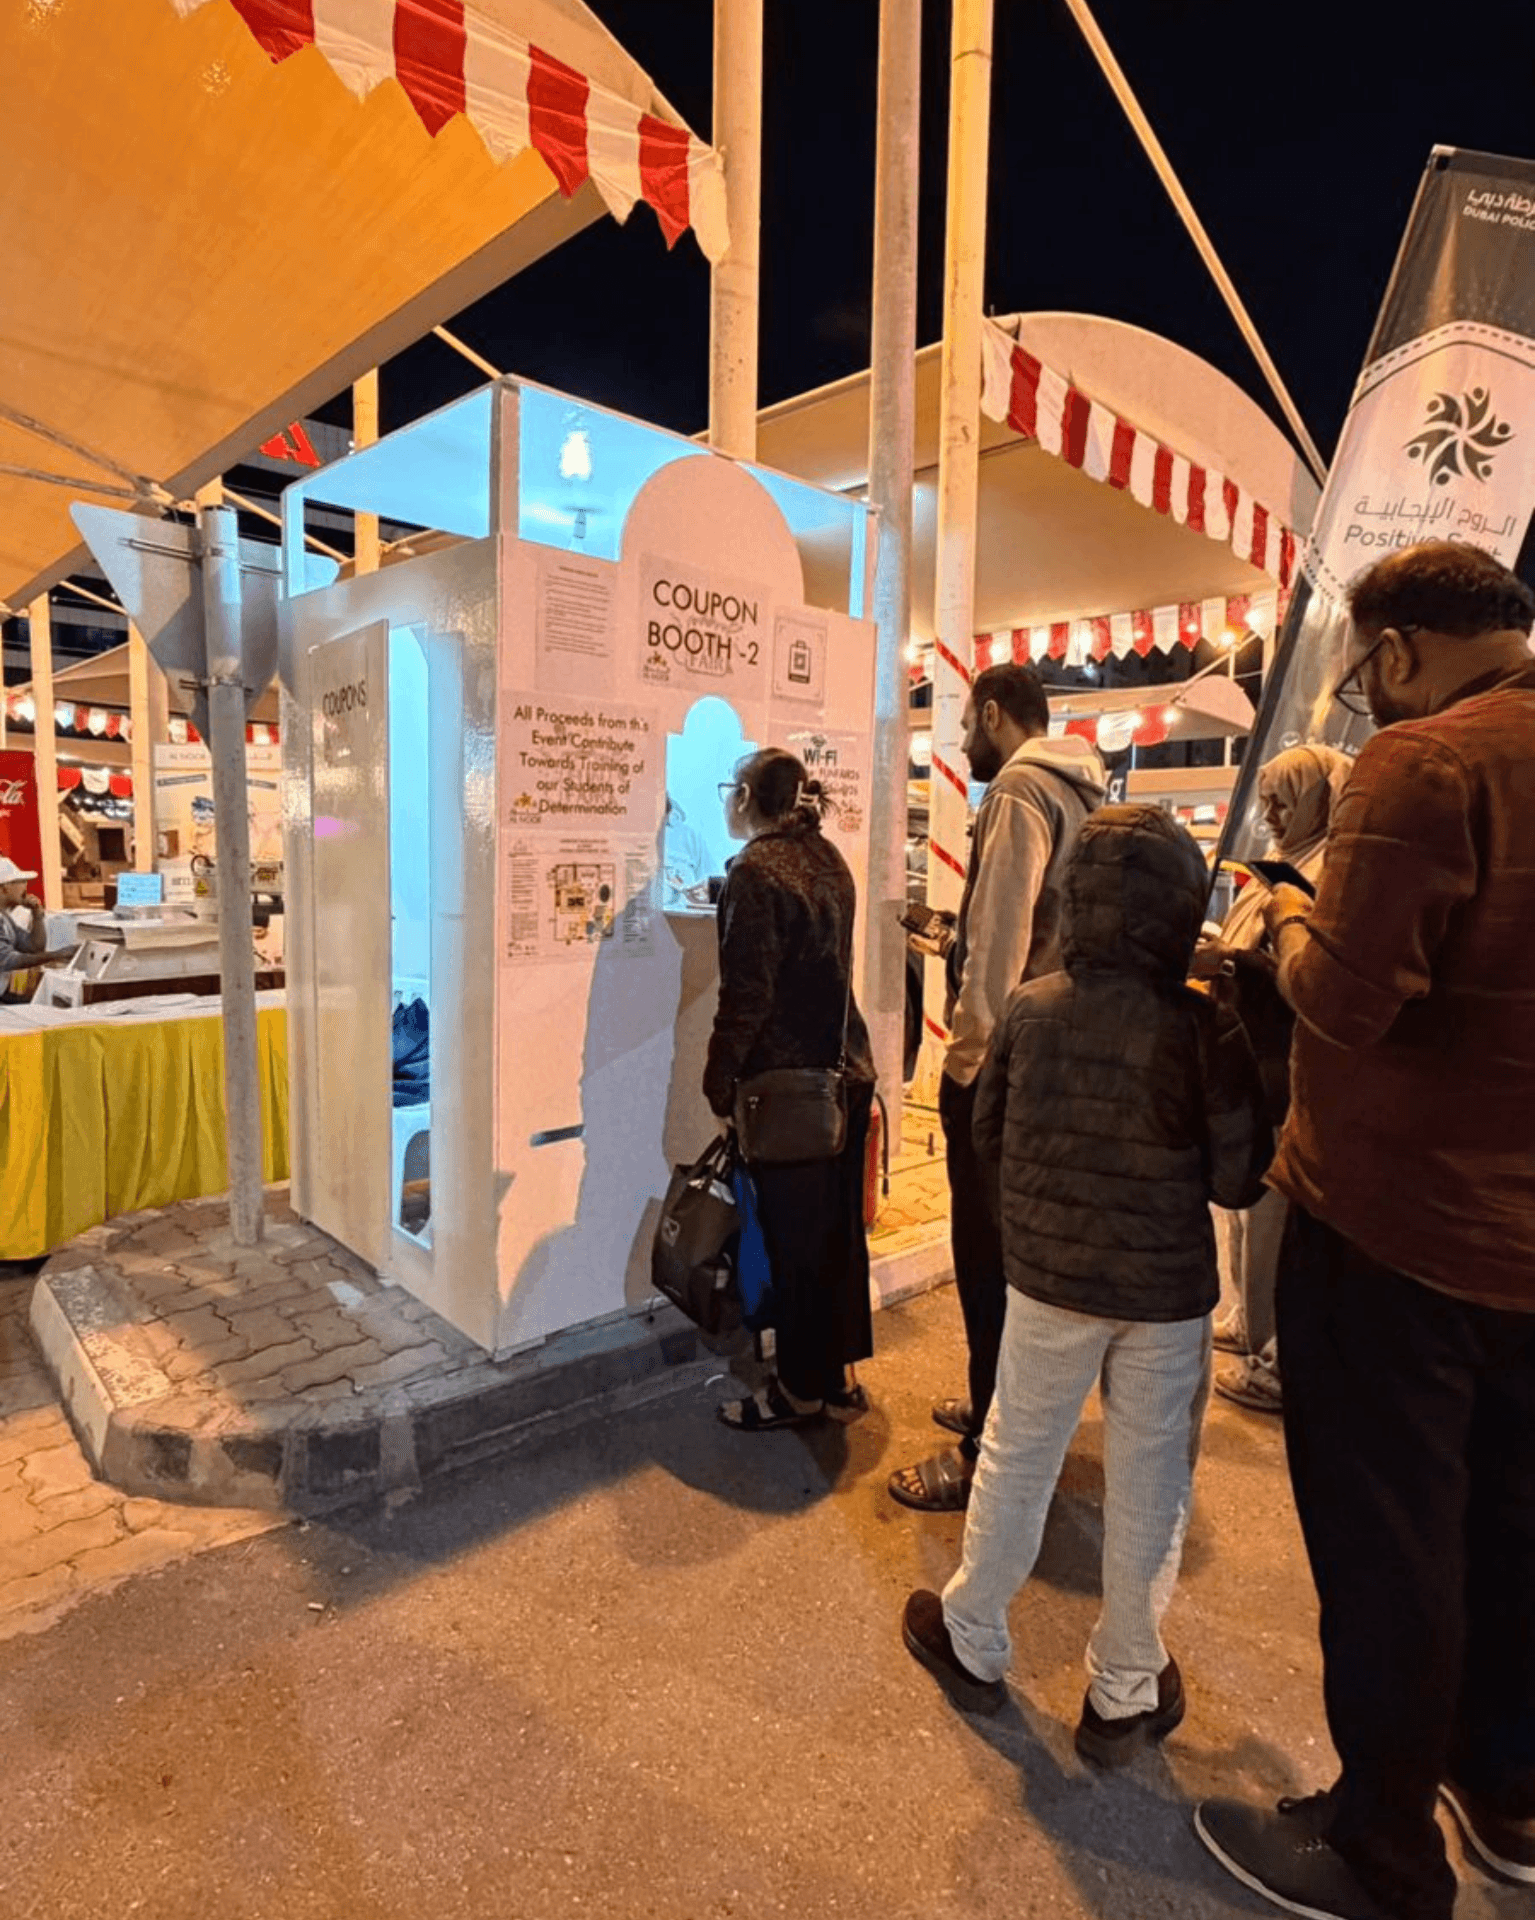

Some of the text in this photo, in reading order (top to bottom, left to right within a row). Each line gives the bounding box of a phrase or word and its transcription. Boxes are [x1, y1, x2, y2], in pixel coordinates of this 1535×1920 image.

[1462, 205, 1501, 223] DUBAI
[653, 579, 758, 626] COUPON
[647, 619, 732, 661] BOOTH
[739, 640, 759, 666] -2
[322, 680, 367, 718] COUPONS
[514, 705, 533, 721] All
[536, 707, 595, 727] Proceeds
[598, 712, 627, 730] from
[532, 729, 635, 752] Event Contribute
[519, 751, 645, 776] Towards Training of
[536, 777, 631, 795] our Students of
[538, 799, 627, 815] Determination
